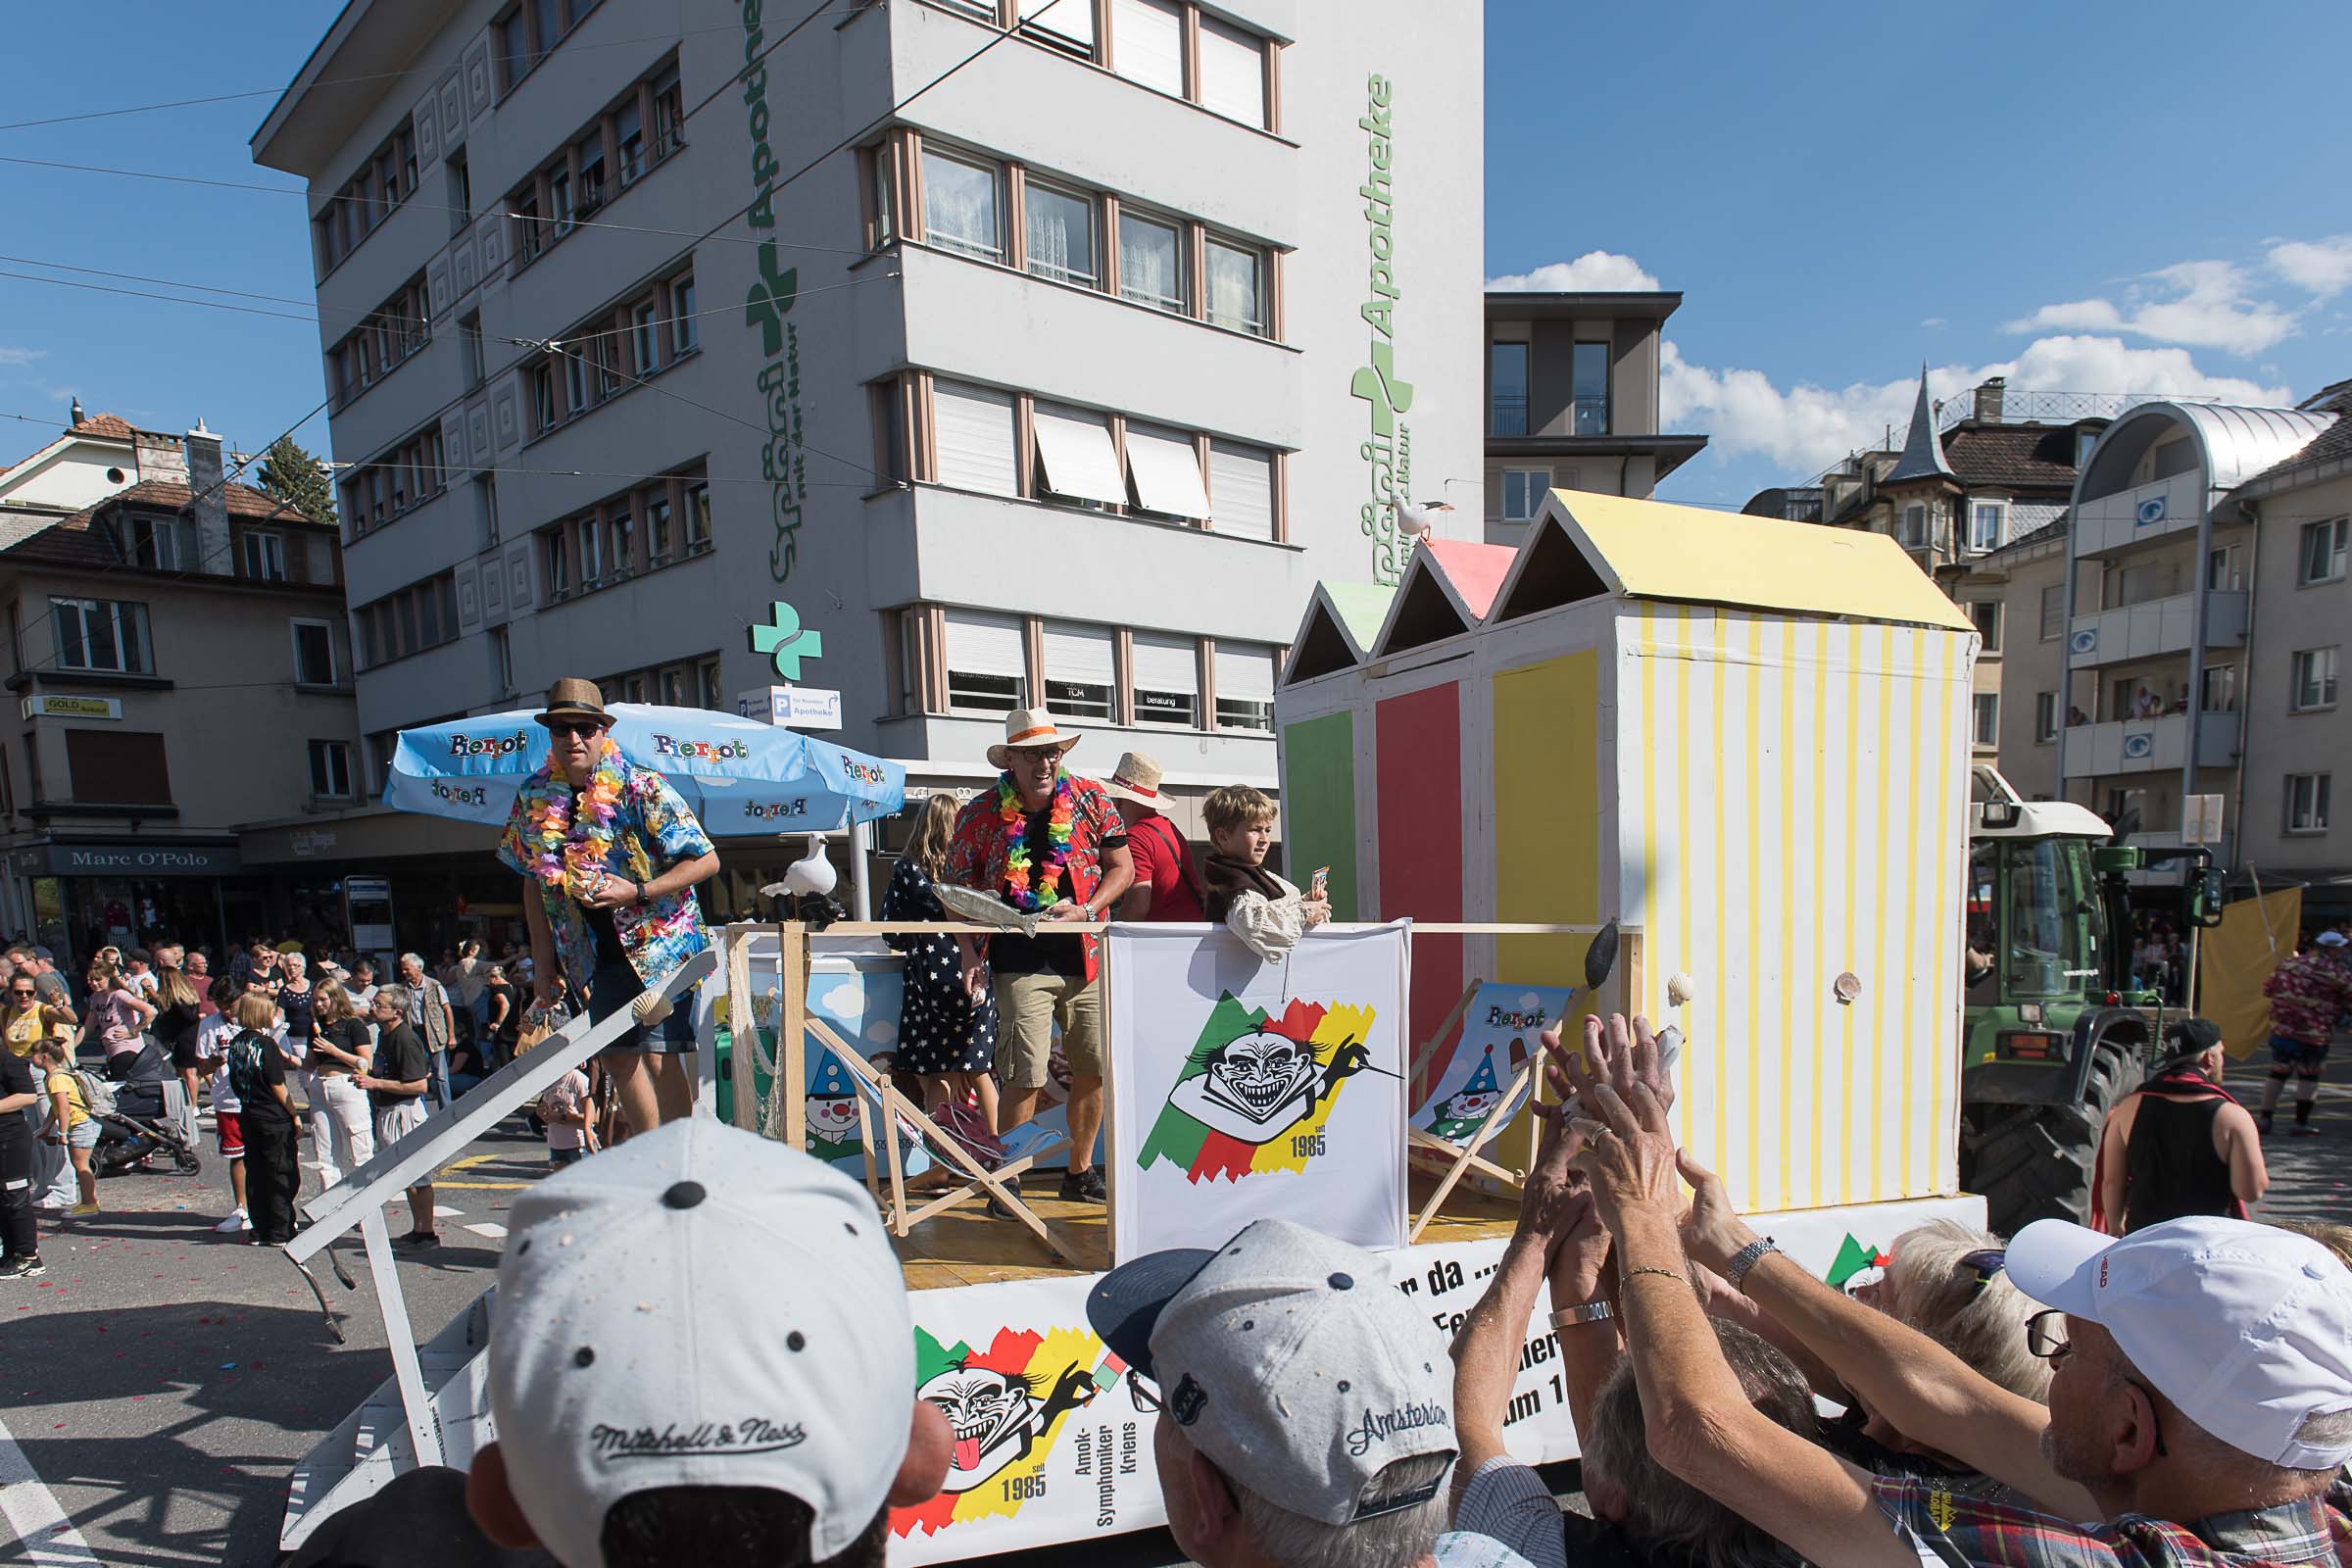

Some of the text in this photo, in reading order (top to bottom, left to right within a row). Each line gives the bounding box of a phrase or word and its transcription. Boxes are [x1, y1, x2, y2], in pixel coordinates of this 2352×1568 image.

[735, 0, 779, 227] Apothe
[1359, 73, 1400, 338] Apotheke
[787, 321, 806, 500] mit der Natur
[1360, 444, 1402, 588] päni
[48, 700, 79, 709] GOLD
[1066, 687, 1085, 698] TCM
[794, 707, 833, 717] Apotheke
[450, 729, 528, 760] Pierrot
[651, 733, 748, 763] Pierrot
[841, 752, 886, 785] Pierrot
[72, 852, 209, 866] Marc O'Polo
[1486, 1005, 1545, 1031] Pierrot
[1291, 1135, 1325, 1157] 1985
[1427, 1259, 1464, 1297] da
[1519, 1330, 1559, 1372] ier
[592, 1417, 808, 1451] Mitchell & Ness
[1120, 1421, 1137, 1475] Kriens
[1032, 1462, 1046, 1474] seit
[1075, 1427, 1092, 1476] Amok-
[1002, 1474, 1047, 1502] 1985
[1097, 1424, 1115, 1527] Symphoniker
